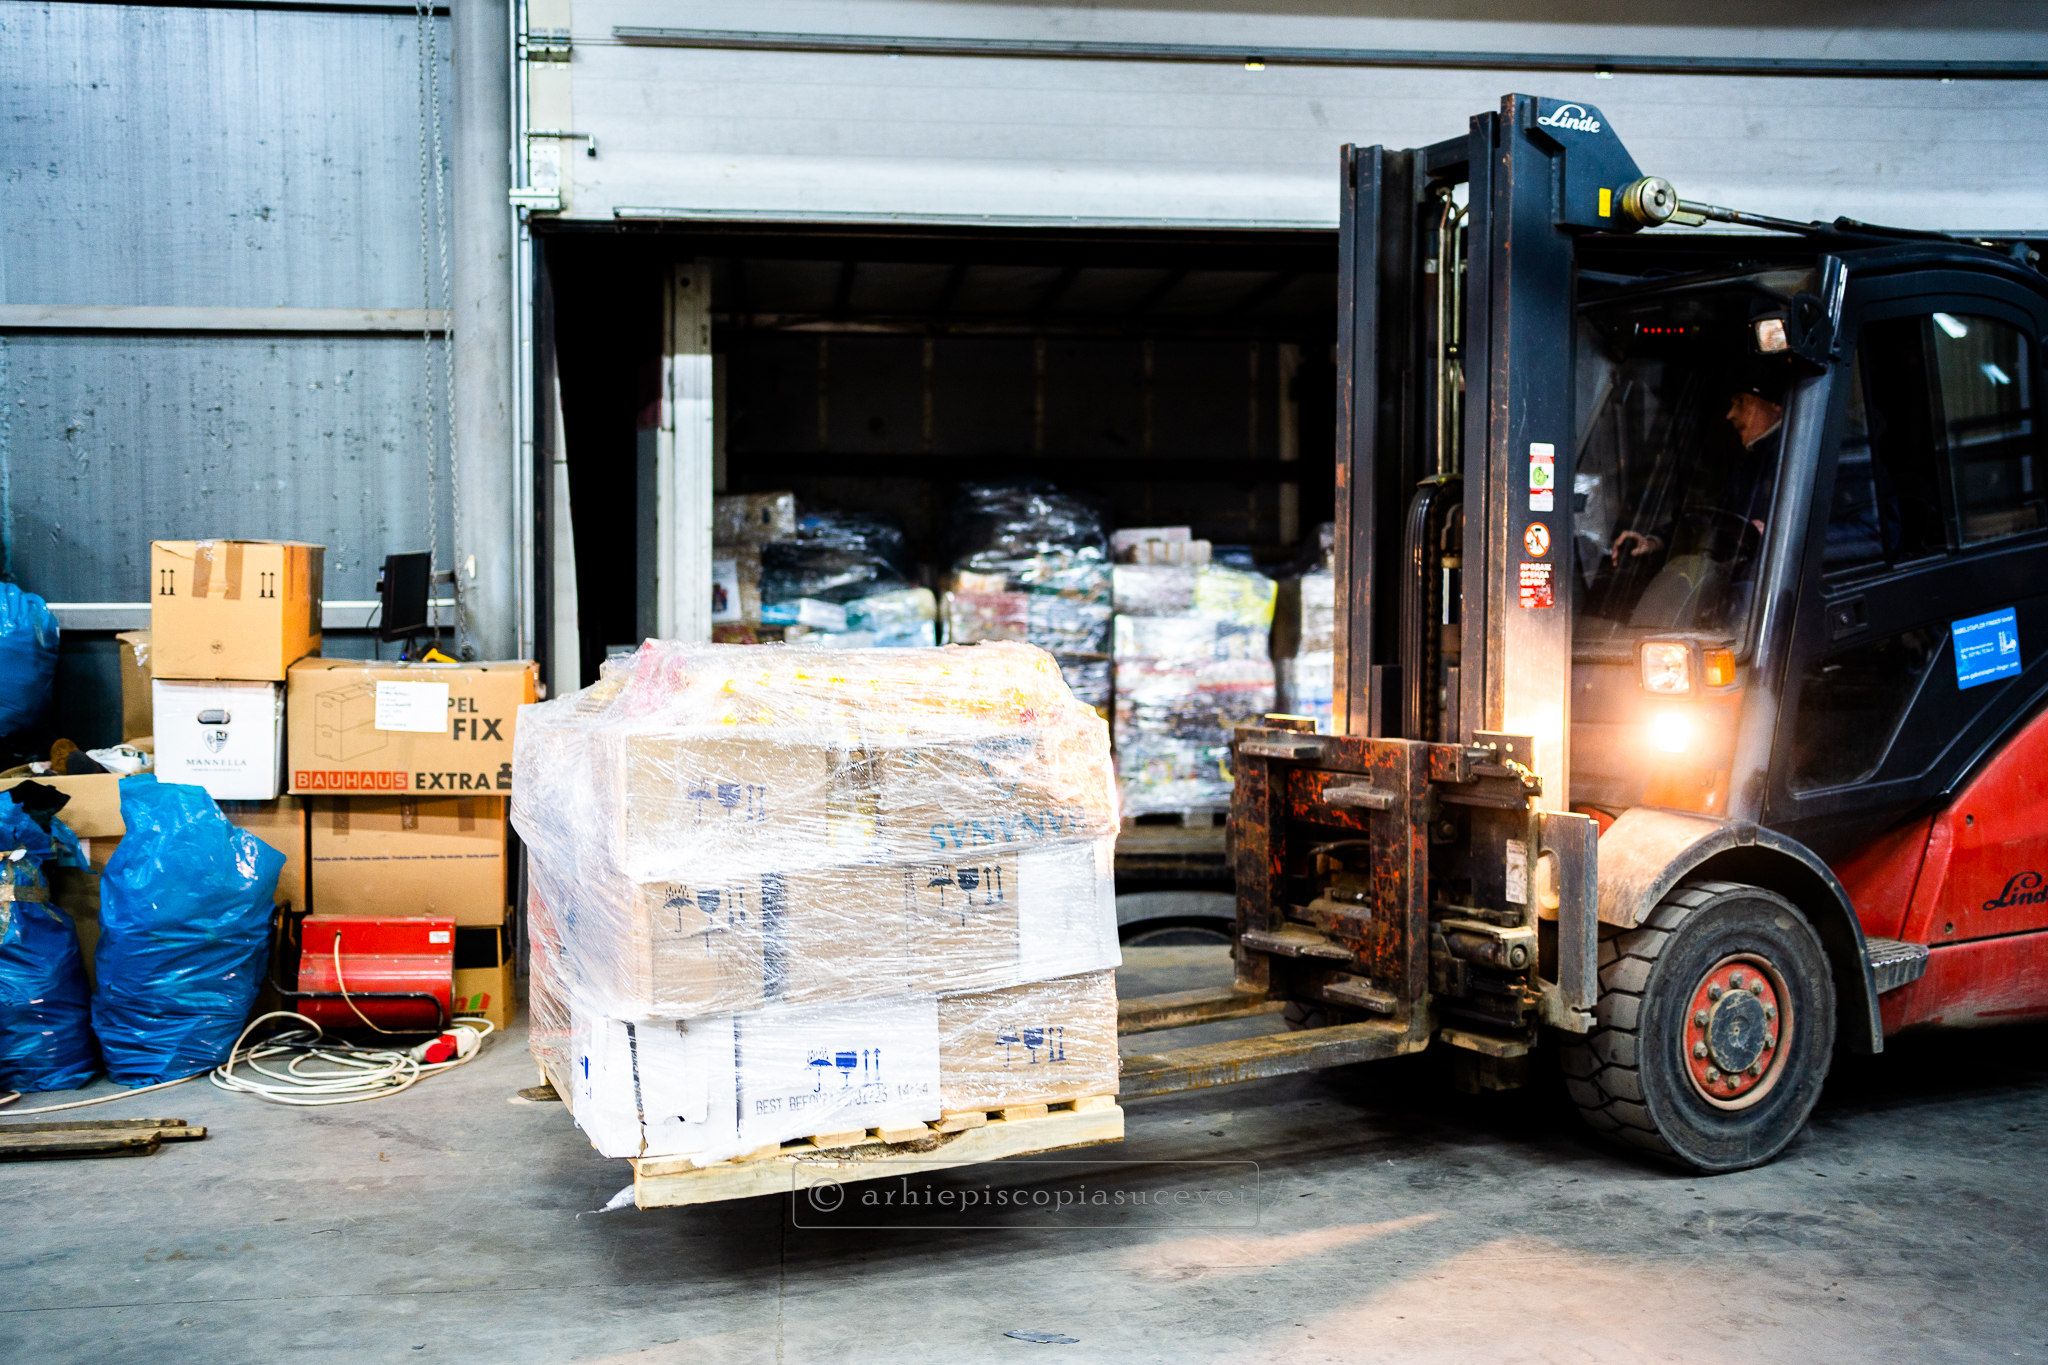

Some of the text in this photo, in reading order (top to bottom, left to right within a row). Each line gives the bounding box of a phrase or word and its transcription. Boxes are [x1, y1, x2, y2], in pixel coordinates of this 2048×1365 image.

[1537, 104, 1600, 133] Linde
[1520, 563, 1552, 571] ПРОДАЖ
[1520, 571, 1550, 579] ОРЕНДА
[453, 718, 503, 741] FIX
[186, 758, 247, 766] MANNELLA
[298, 772, 407, 788] BAUHAUS
[416, 772, 491, 789] EXTRA
[929, 805, 1086, 852] BANANAS
[756, 1098, 782, 1116] BEST
